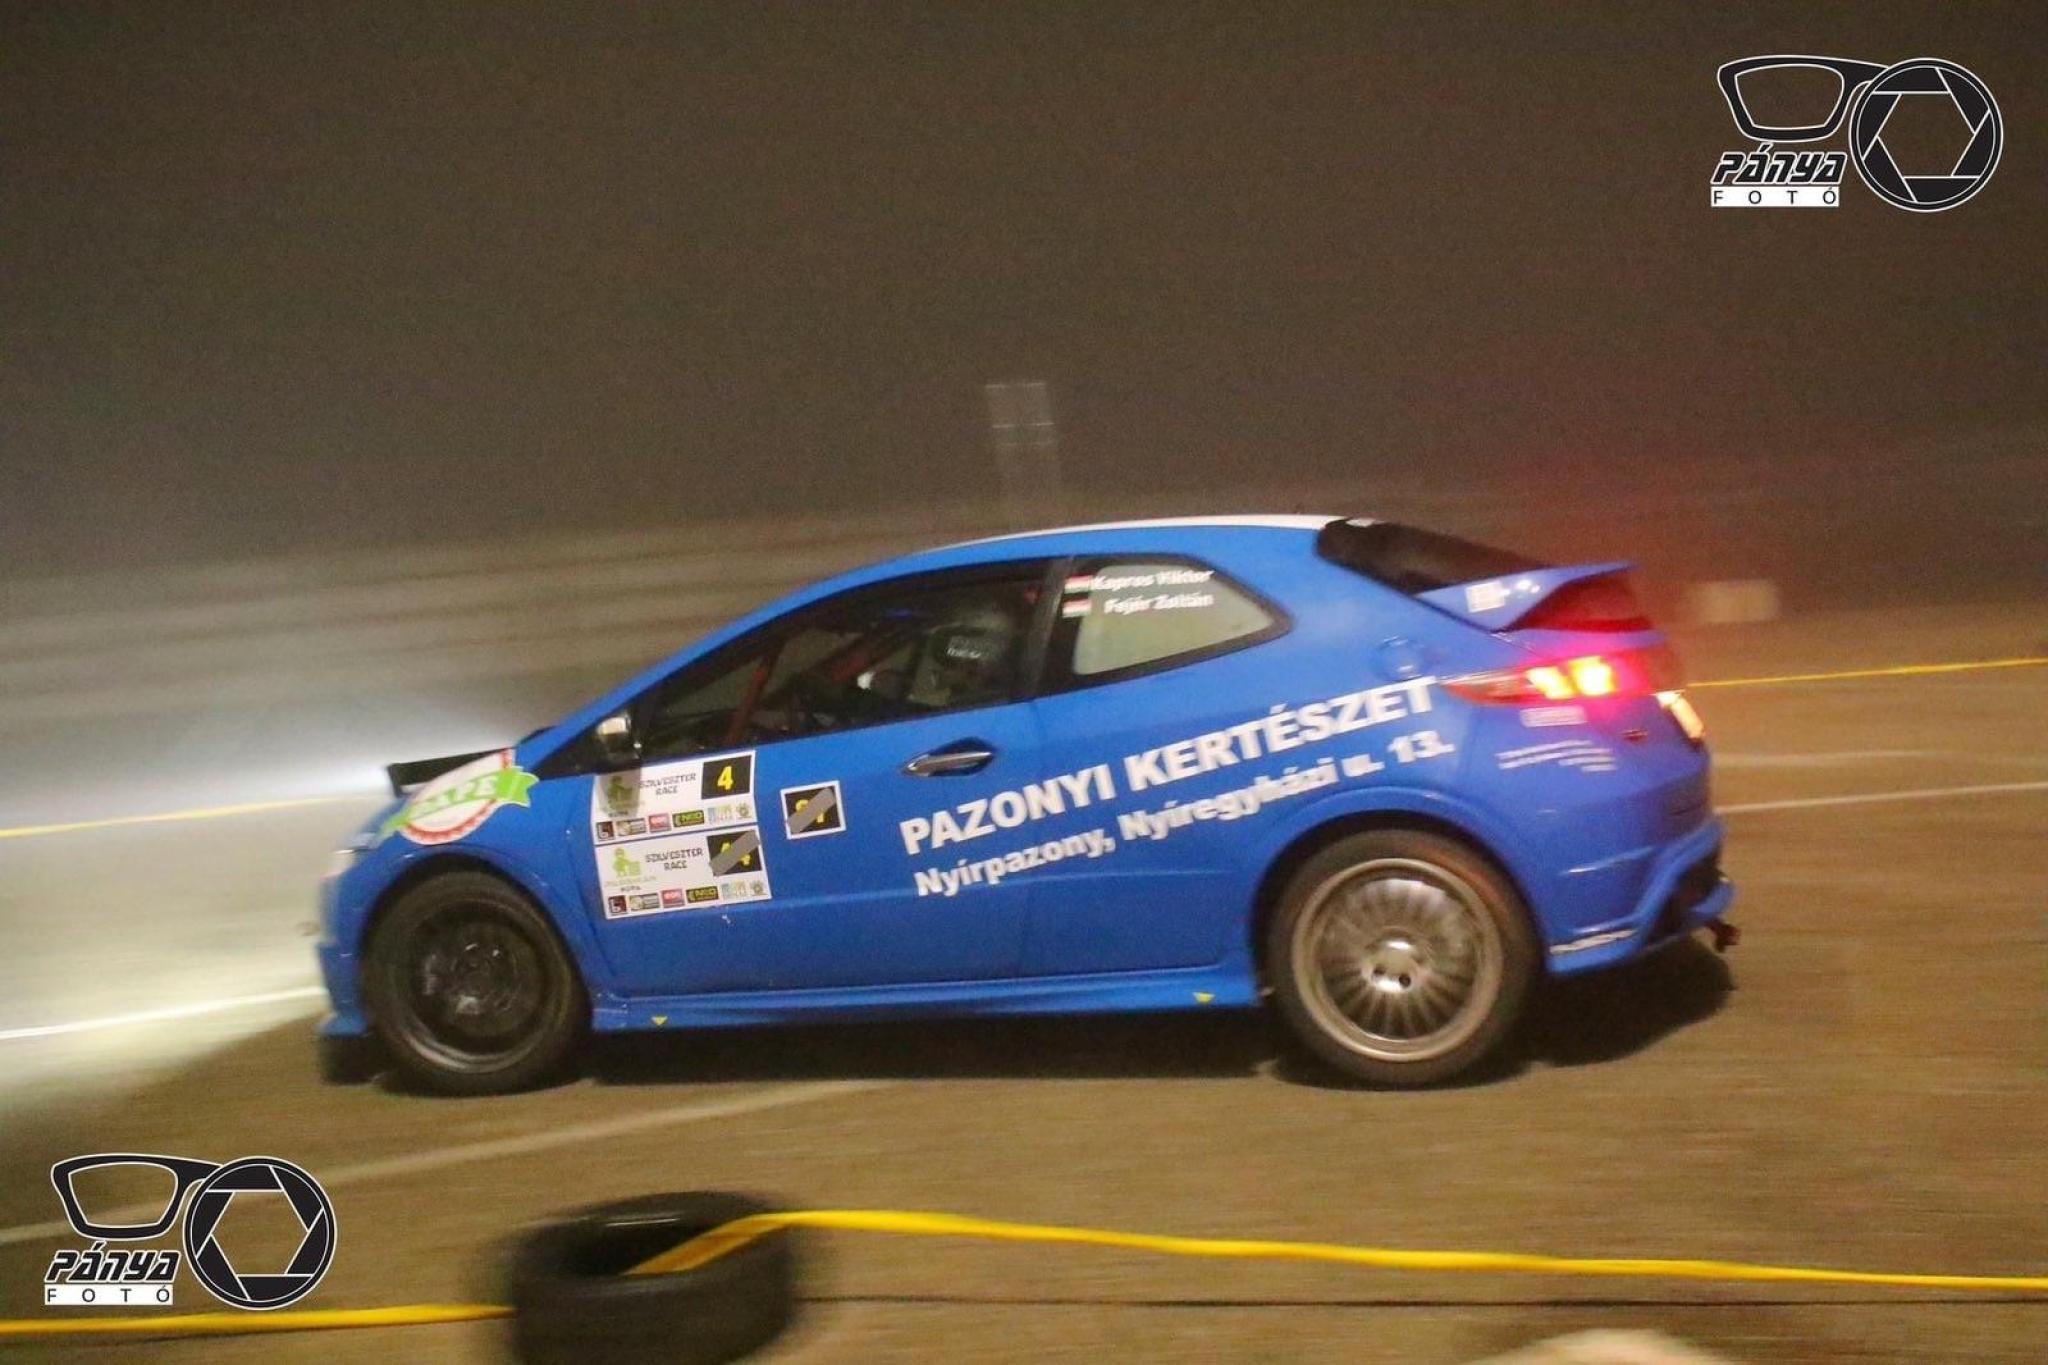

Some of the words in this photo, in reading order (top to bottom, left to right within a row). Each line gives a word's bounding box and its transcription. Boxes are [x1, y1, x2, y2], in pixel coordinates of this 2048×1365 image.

[717, 765, 734, 791] 4
[900, 764, 1117, 855] PAZONYI
[1123, 676, 1436, 792] KERTÉSZET
[655, 785, 679, 796] RACE
[914, 828, 1116, 897] Nyírpazony,
[1117, 756, 1339, 840] Nyíregyházi
[1341, 753, 1385, 777] u.
[1387, 730, 1455, 763] 13.
[664, 860, 688, 871] RACE
